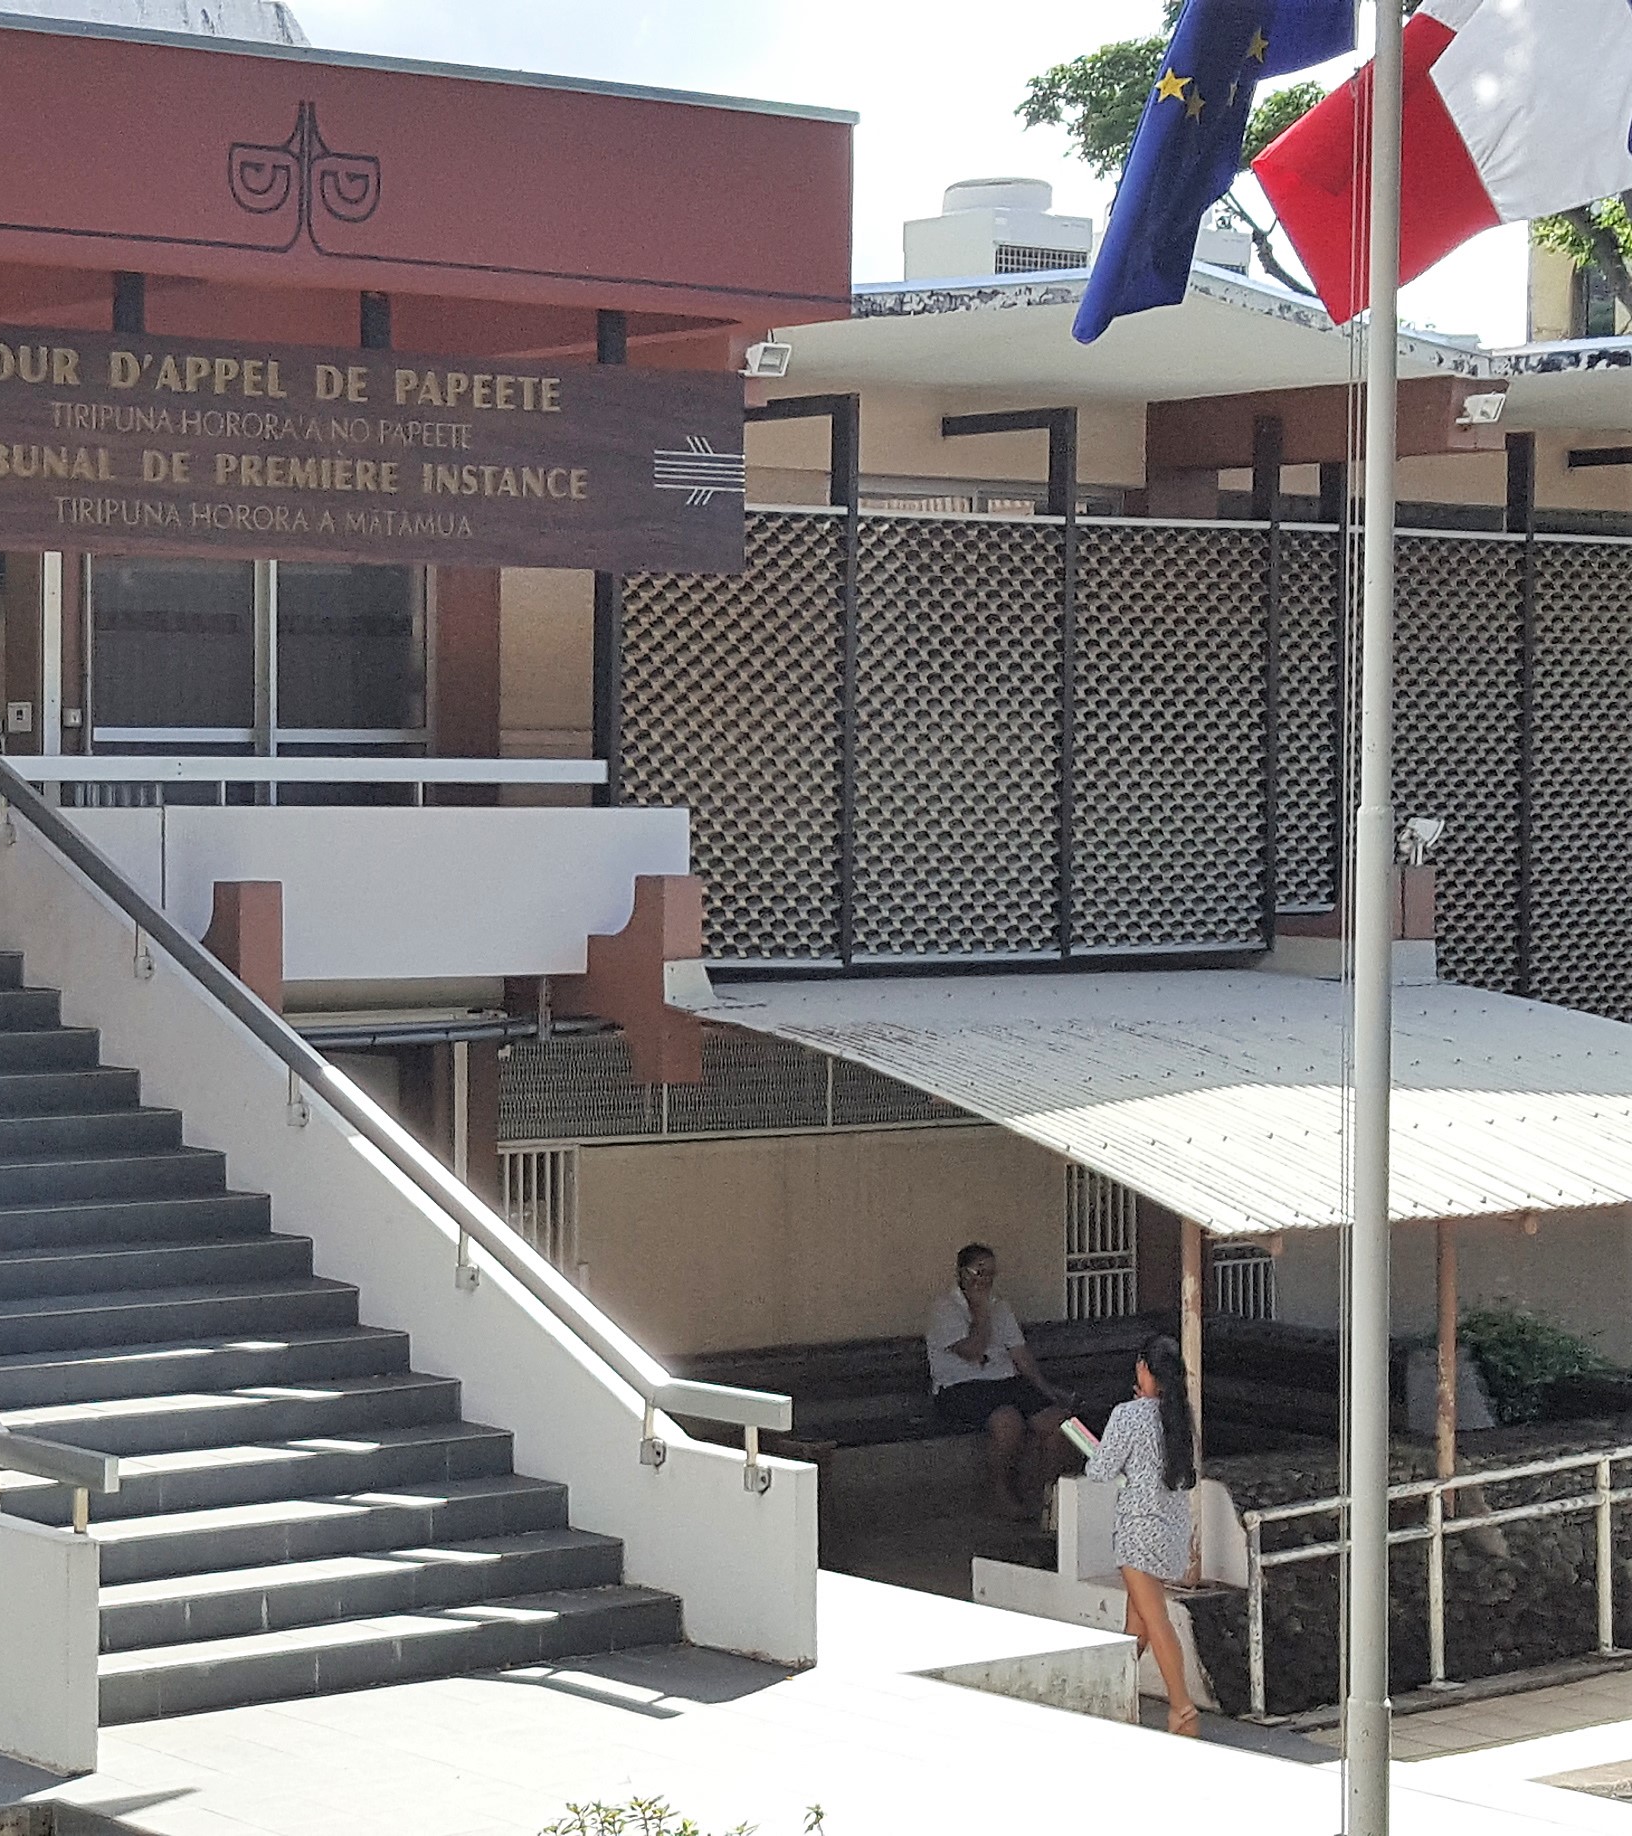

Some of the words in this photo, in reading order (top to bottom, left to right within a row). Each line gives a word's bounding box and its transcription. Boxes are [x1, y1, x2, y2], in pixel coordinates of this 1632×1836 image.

[110, 351, 287, 398] D'APPEL
[316, 364, 368, 403] DE
[395, 368, 562, 413] PAPEETE
[51, 402, 174, 433] TIRIPUNA
[331, 416, 369, 443] NO
[380, 418, 472, 449] PAPEETE
[143, 449, 191, 483] DE
[216, 450, 399, 494] PREMIÈRE
[423, 462, 588, 500] INSTANCE
[55, 496, 182, 527] TIRIPUNA
